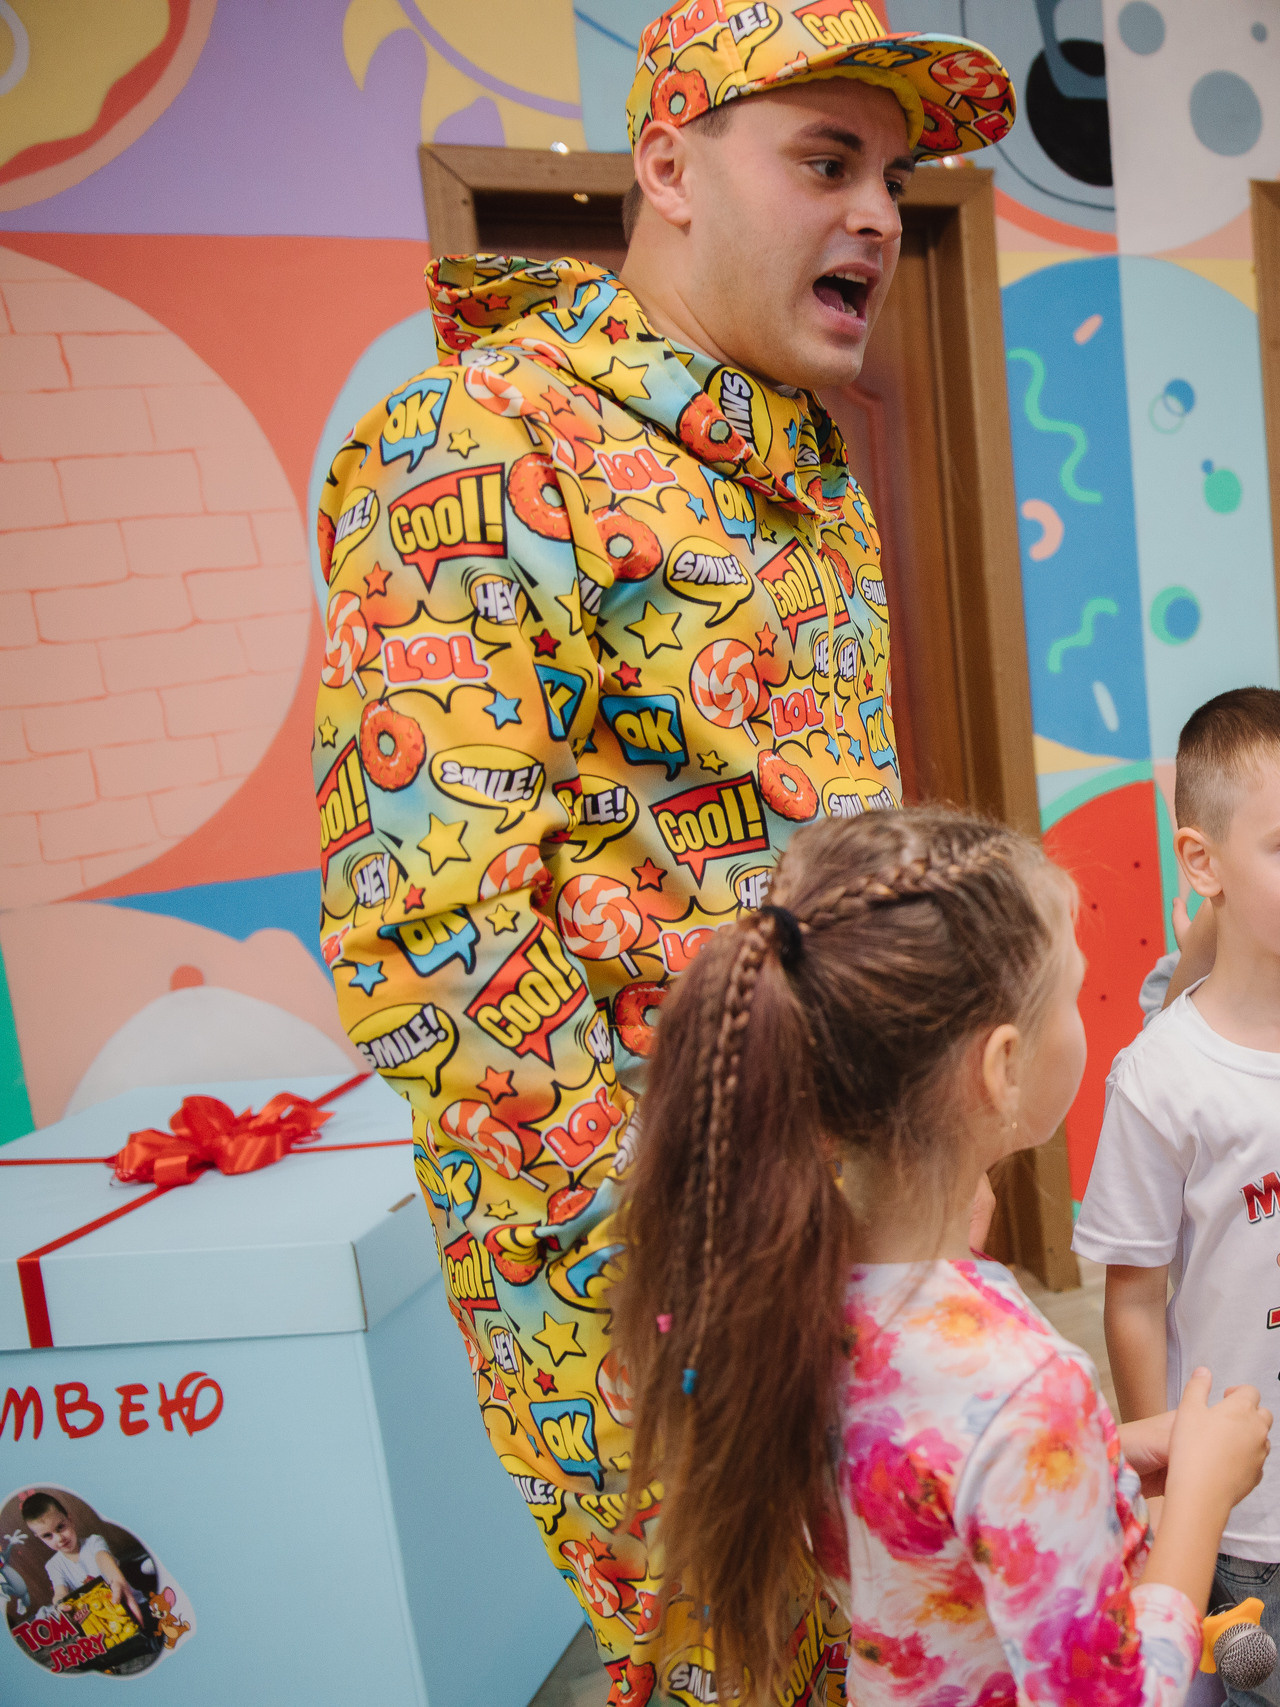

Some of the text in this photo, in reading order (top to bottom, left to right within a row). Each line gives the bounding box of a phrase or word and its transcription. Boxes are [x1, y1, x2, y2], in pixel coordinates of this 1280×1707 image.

[382, 391, 443, 445] OK
[594, 447, 677, 492] LOL
[671, 550, 748, 586] SMILE!
[474, 580, 520, 623] HEY
[383, 634, 490, 684] LOL
[840, 640, 859, 679] HEY
[613, 709, 684, 754] OK
[771, 687, 825, 739] LOL
[865, 709, 891, 753] OK
[441, 761, 542, 802] SMILE!
[354, 852, 390, 904] HEY
[739, 871, 773, 909] HE
[491, 1332, 520, 1375] HEY
[541, 1409, 596, 1463] OK
[11, 1608, 79, 1653] TOM
[49, 1632, 107, 1674] JERRY
